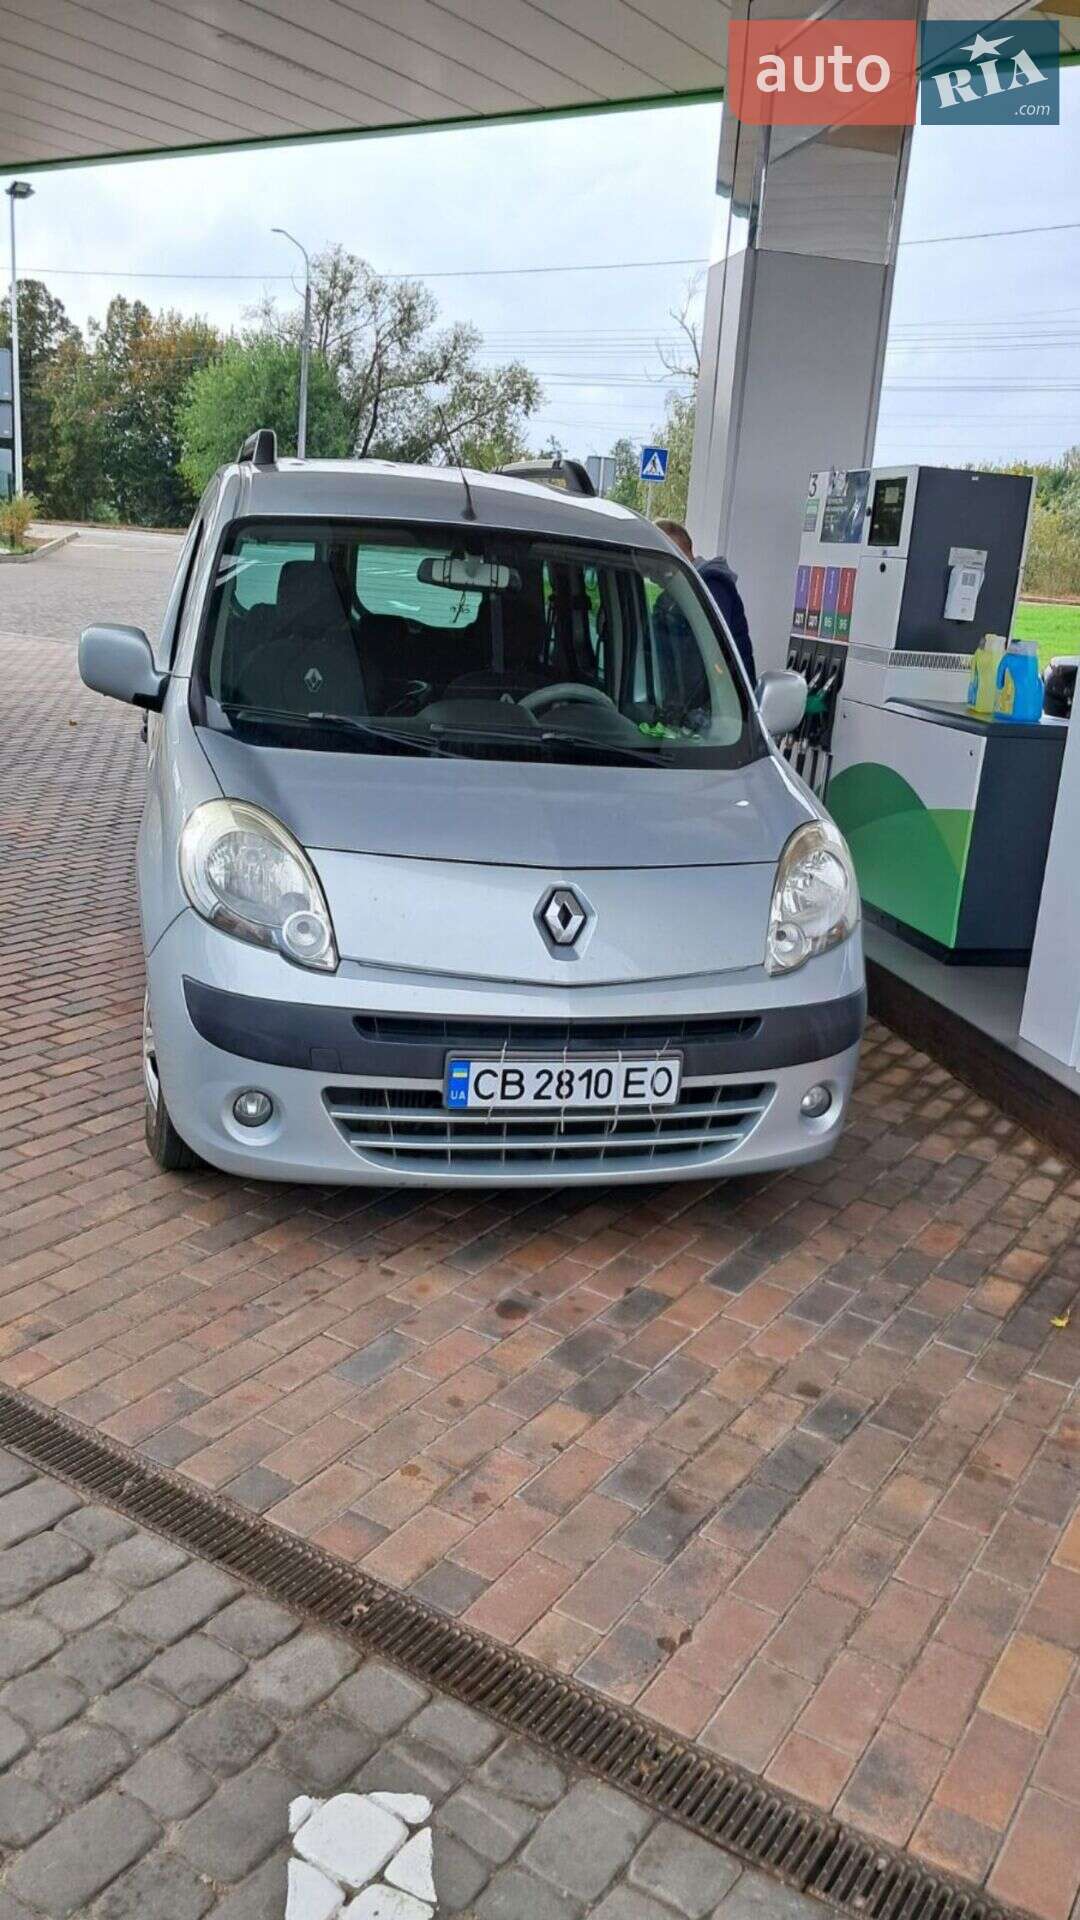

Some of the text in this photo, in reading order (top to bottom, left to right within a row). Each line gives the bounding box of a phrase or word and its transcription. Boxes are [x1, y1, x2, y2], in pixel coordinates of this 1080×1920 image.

[808, 472, 819, 497] 3
[450, 1090, 466, 1100] UA
[473, 1066, 673, 1100] CB 2810 EO
